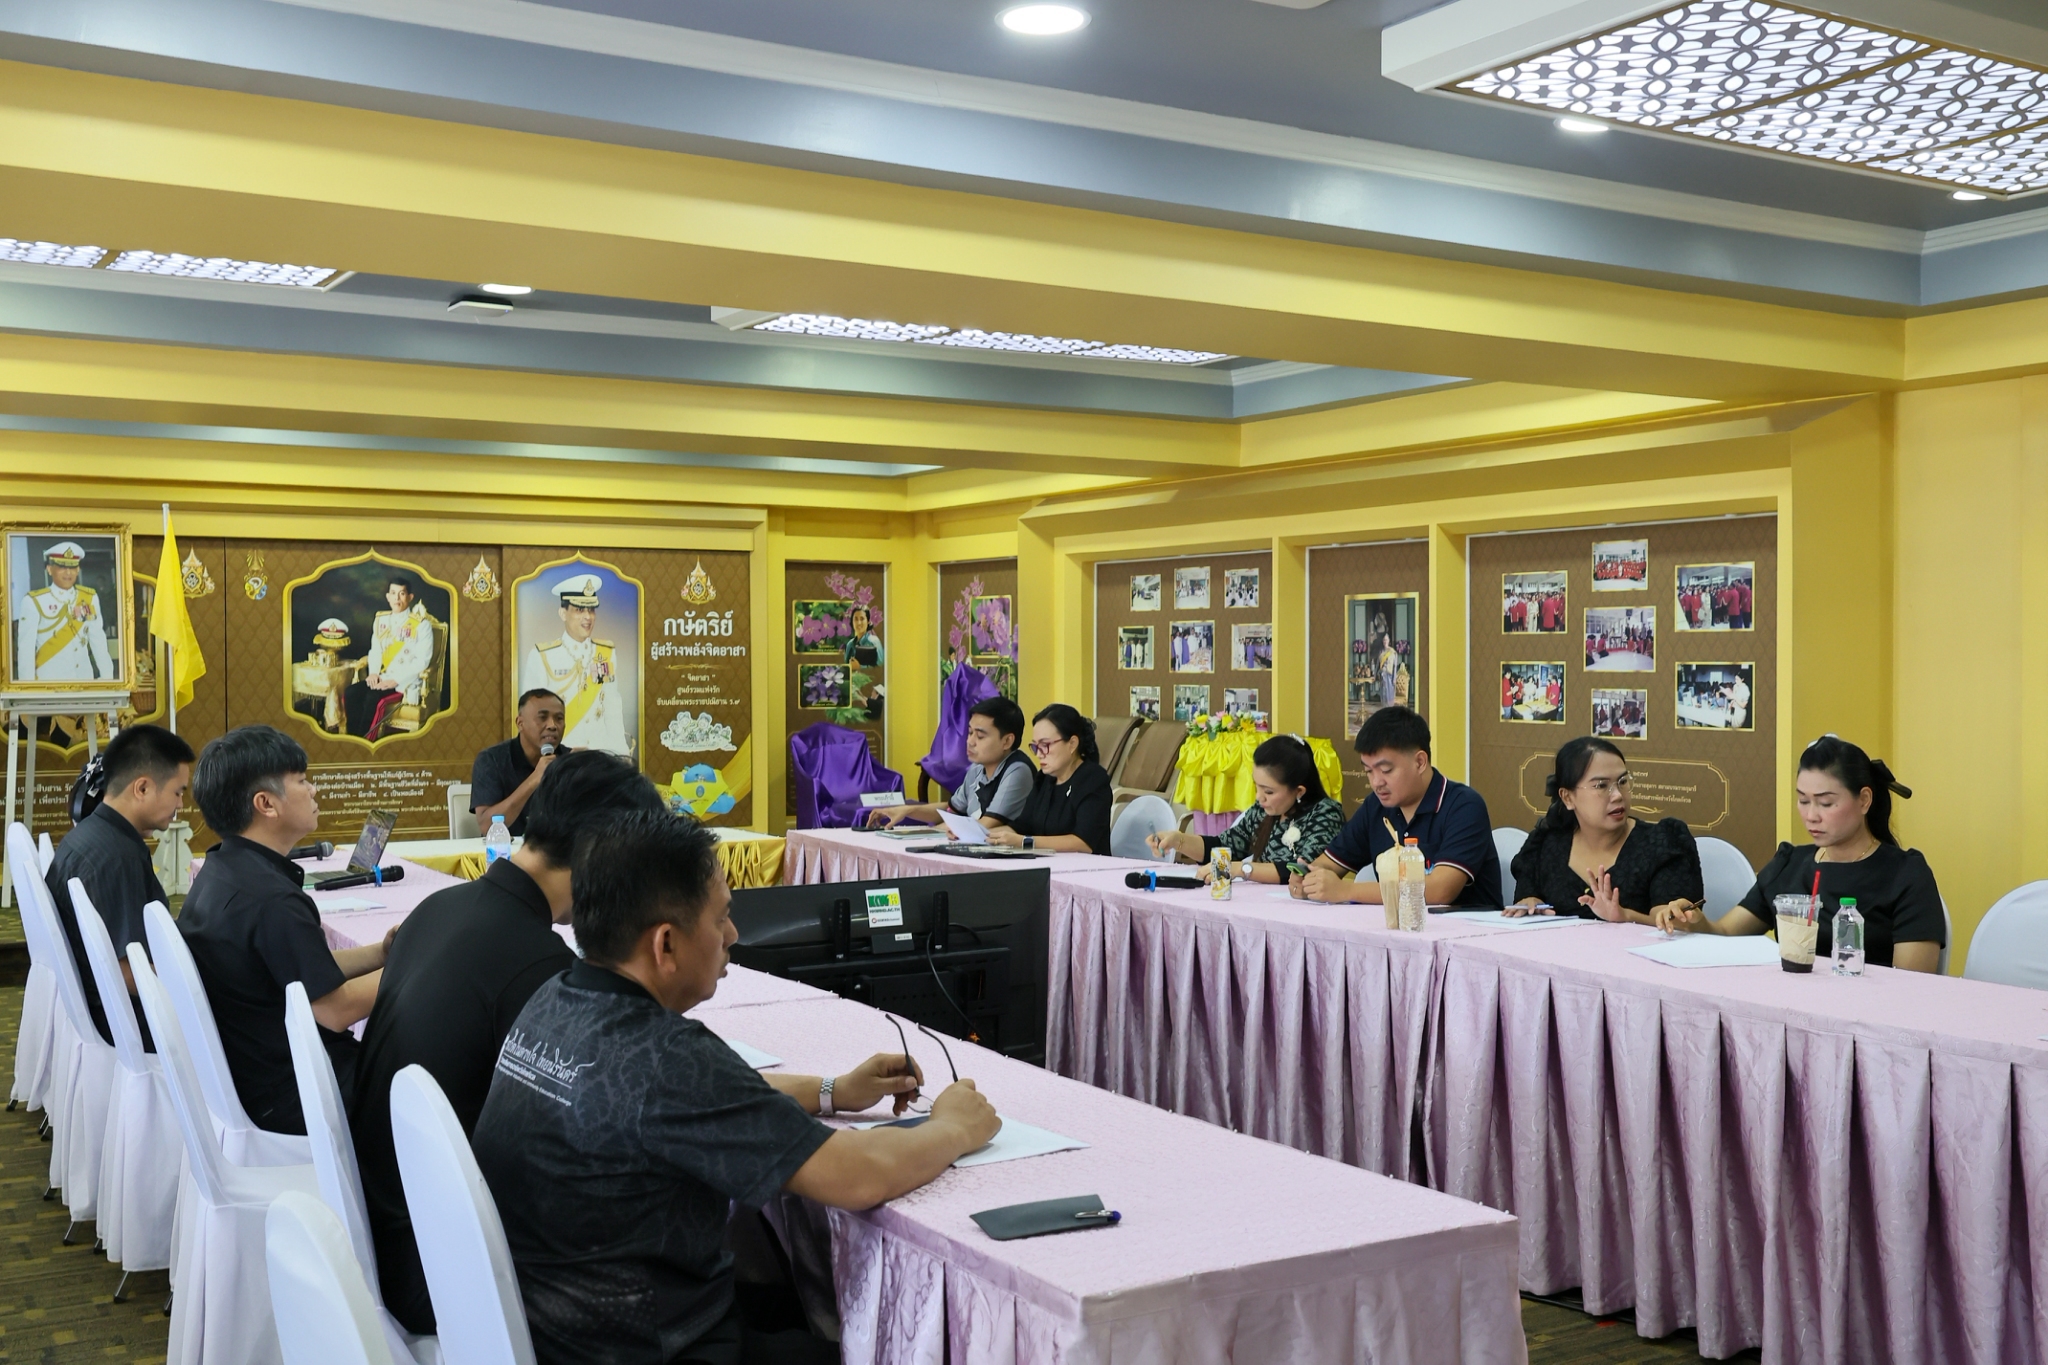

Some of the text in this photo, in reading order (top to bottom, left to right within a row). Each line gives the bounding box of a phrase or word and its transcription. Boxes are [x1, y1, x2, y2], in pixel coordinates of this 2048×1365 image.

[663, 610, 734, 636] กษัตริย์
[651, 641, 746, 661] ผู้สร้างพลังจิตอาสา
[39, 794, 69, 806] เพื่อประโ
